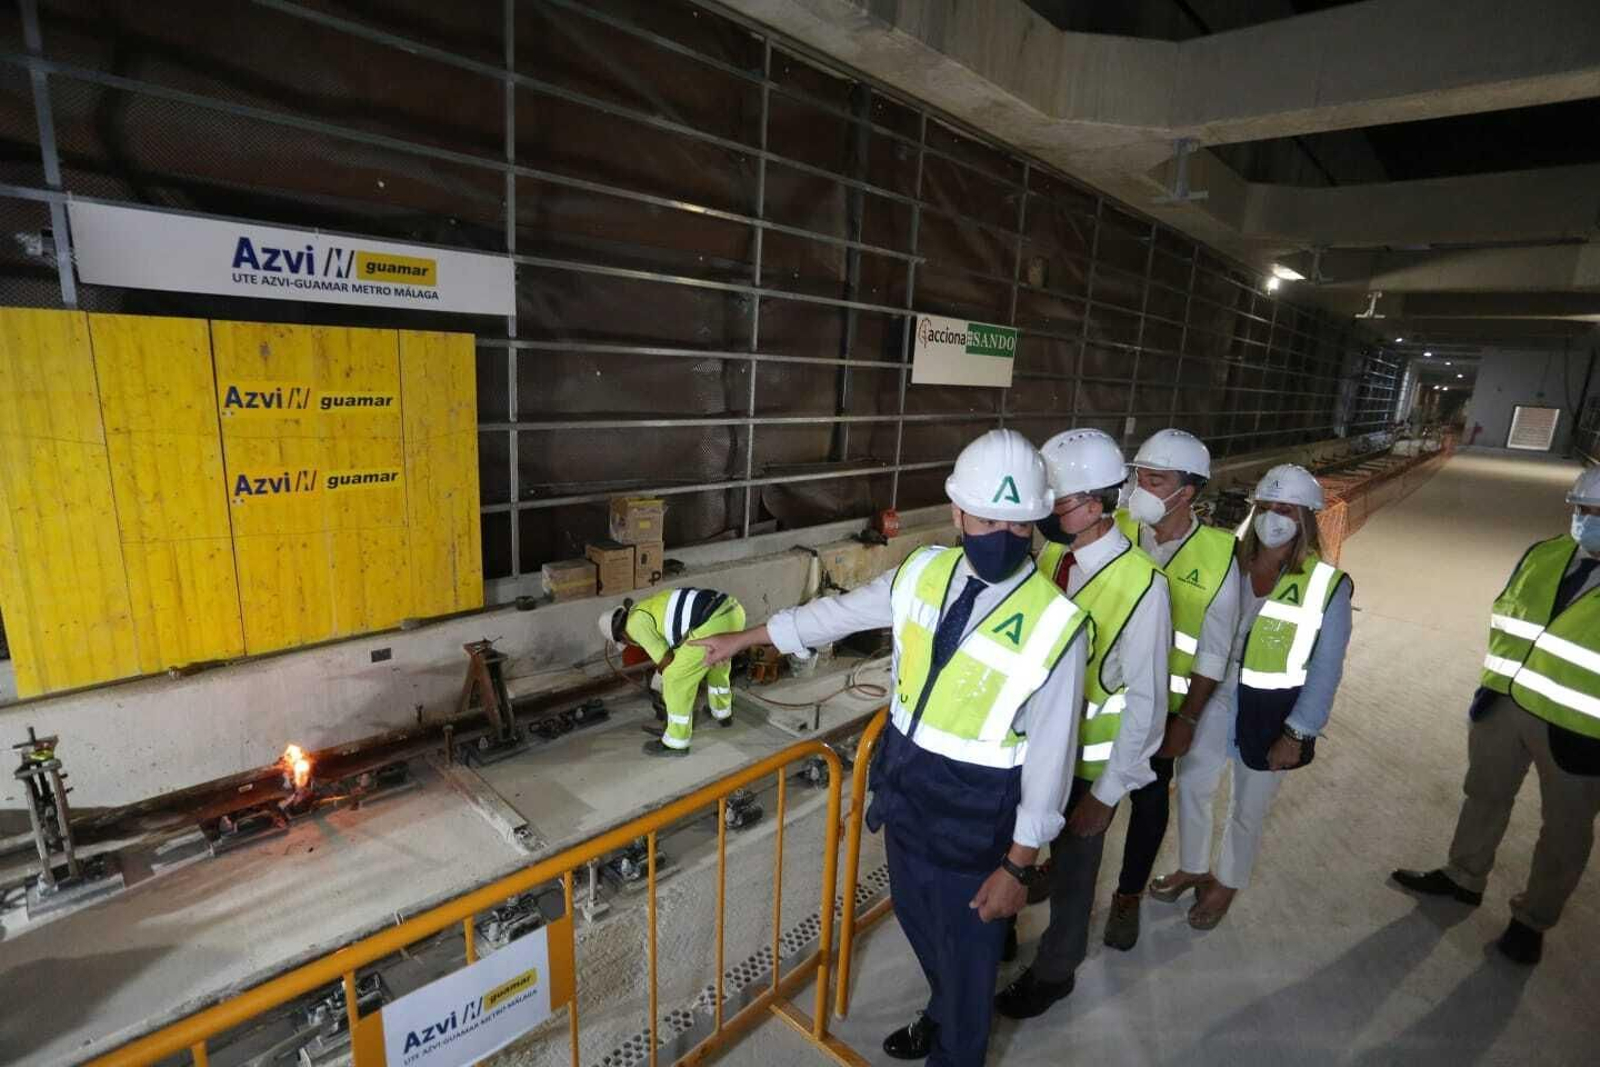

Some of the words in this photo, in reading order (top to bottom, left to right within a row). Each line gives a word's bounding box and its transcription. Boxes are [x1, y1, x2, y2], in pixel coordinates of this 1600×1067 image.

[232, 236, 315, 275] Azvi
[366, 260, 429, 277] guamar
[232, 273, 258, 285] UTE
[261, 276, 349, 293] AZVI-GUAMAR
[351, 284, 391, 296] METRO
[394, 284, 439, 300] MÁLAGA
[928, 327, 966, 345] acciona
[973, 331, 1014, 351] SANDO
[224, 385, 283, 409] Azvi
[320, 396, 393, 410] guamar
[234, 472, 291, 496] Azvi
[327, 472, 398, 489] guamar
[403, 1011, 458, 1055] Azvi
